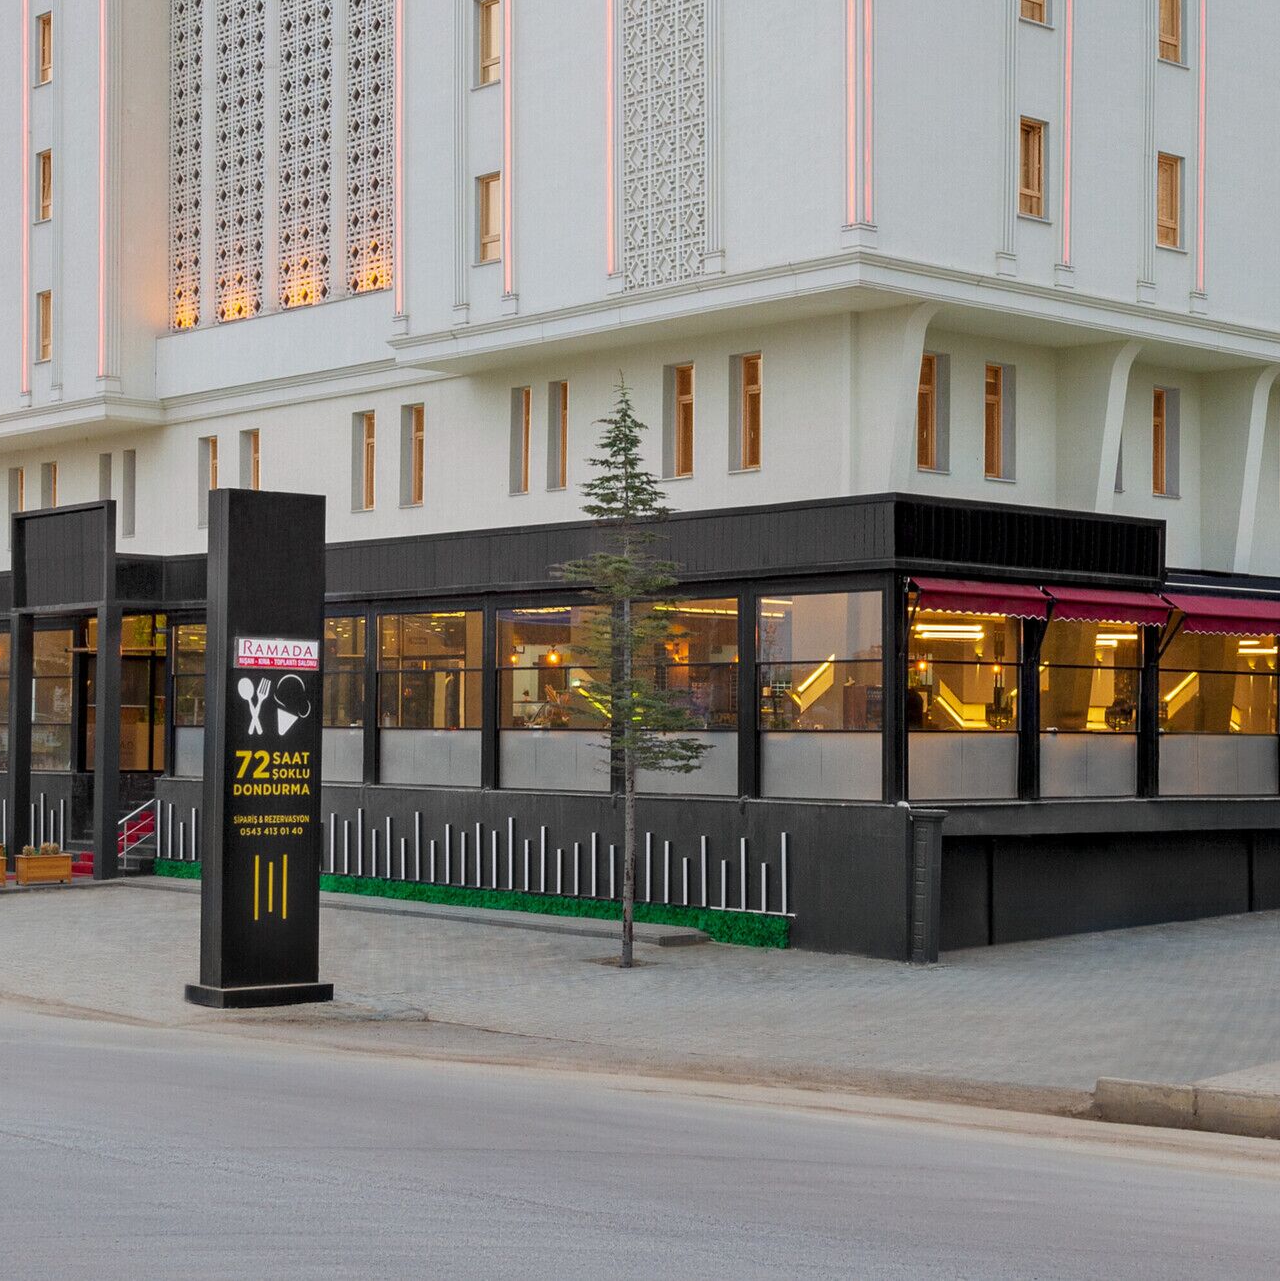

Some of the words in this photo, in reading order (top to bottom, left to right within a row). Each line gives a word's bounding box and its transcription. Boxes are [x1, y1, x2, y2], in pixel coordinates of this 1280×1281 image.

[243, 640, 313, 658] RAMADA
[235, 750, 270, 778] 72
[272, 752, 310, 765] SAAT
[272, 768, 310, 780] ŞOKLU
[233, 784, 310, 796] DONDURMA
[259, 815, 263, 824] &
[264, 814, 310, 823] REZERVASYON
[240, 827, 261, 836] 0543
[263, 826, 278, 835] 413
[280, 826, 290, 835] 01
[292, 826, 303, 835] 40
